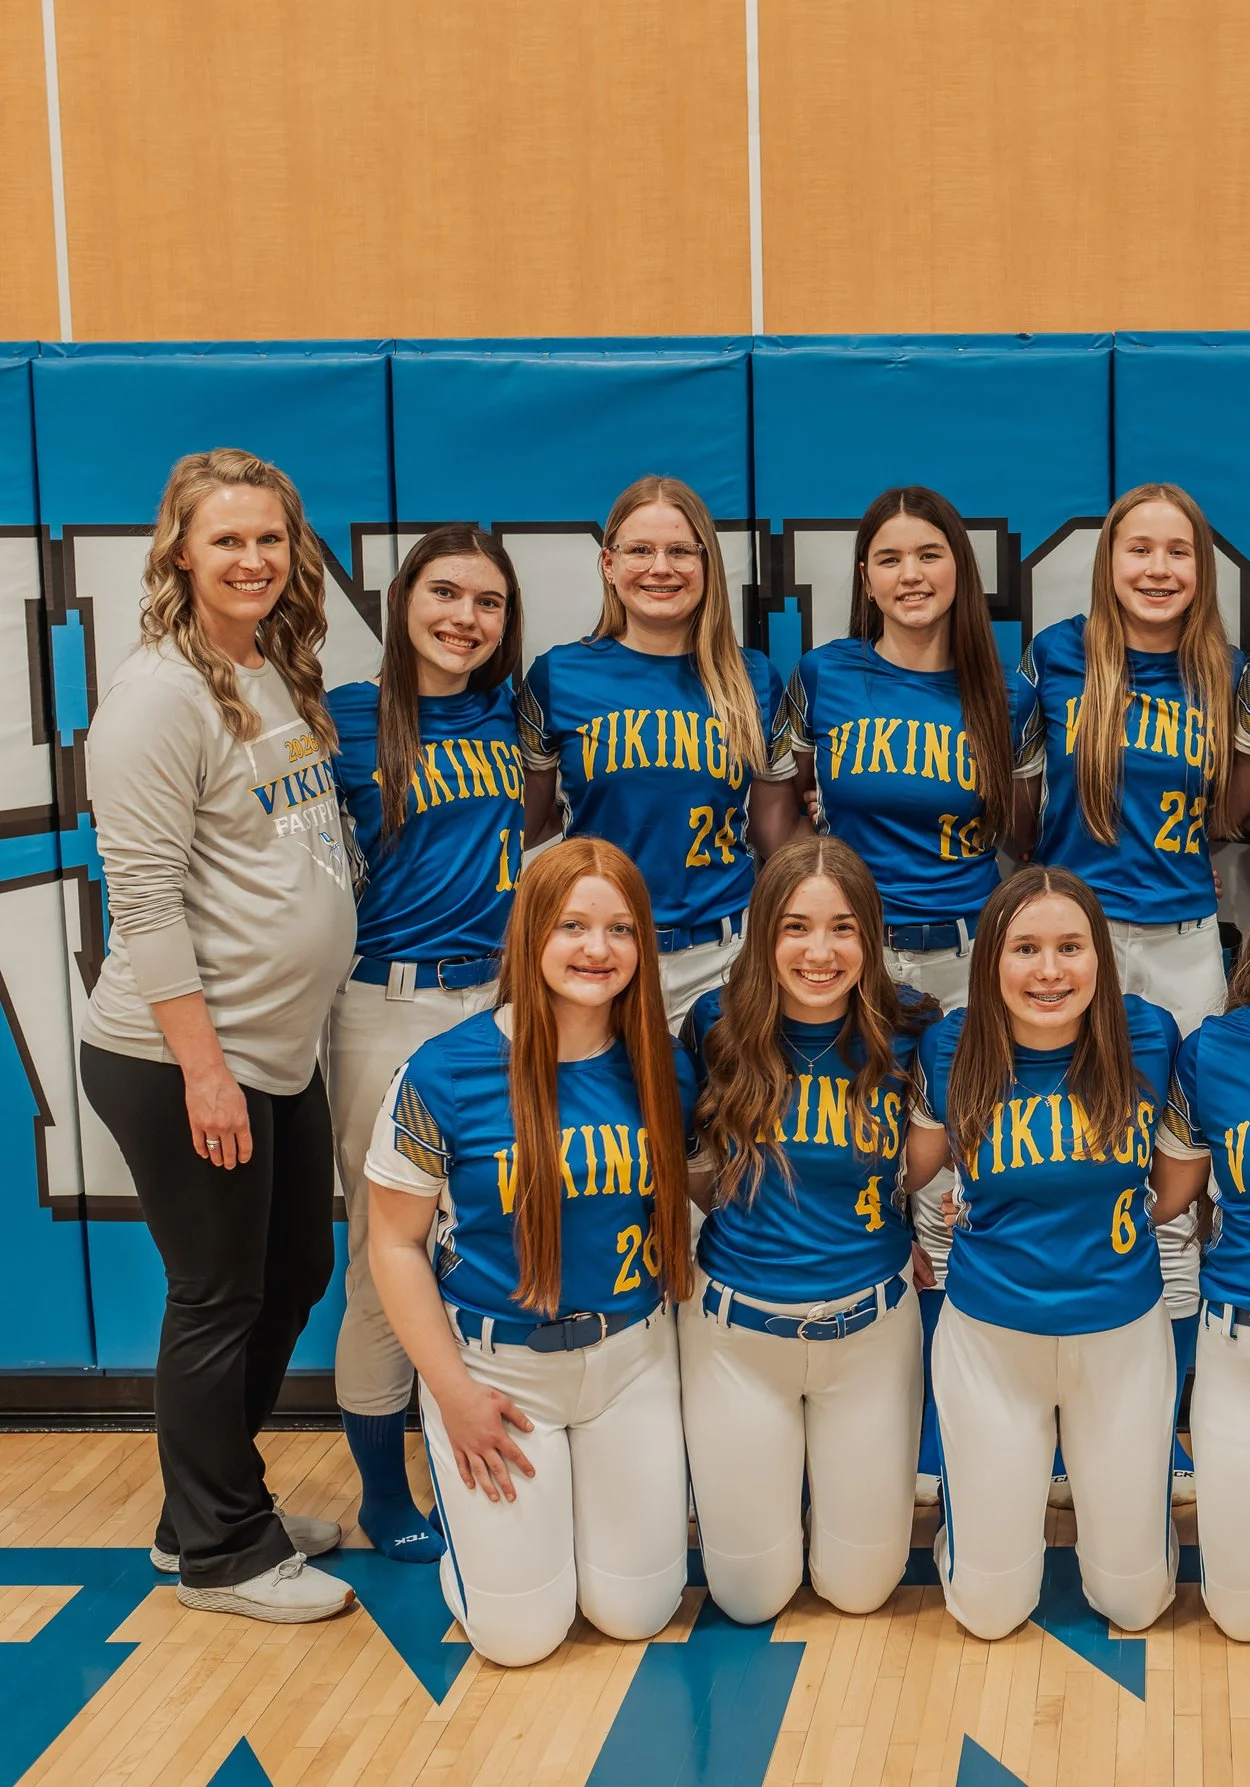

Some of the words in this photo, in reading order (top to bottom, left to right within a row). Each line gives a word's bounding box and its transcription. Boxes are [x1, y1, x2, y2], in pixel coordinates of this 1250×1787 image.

[285, 732, 319, 763] 2026
[828, 718, 985, 799] VIKING
[686, 806, 737, 868] 24
[1154, 791, 1207, 855] 22
[496, 829, 525, 893] 1
[854, 1176, 885, 1232] 4
[1111, 1187, 1137, 1255] 6
[394, 1532, 429, 1546] TCK
